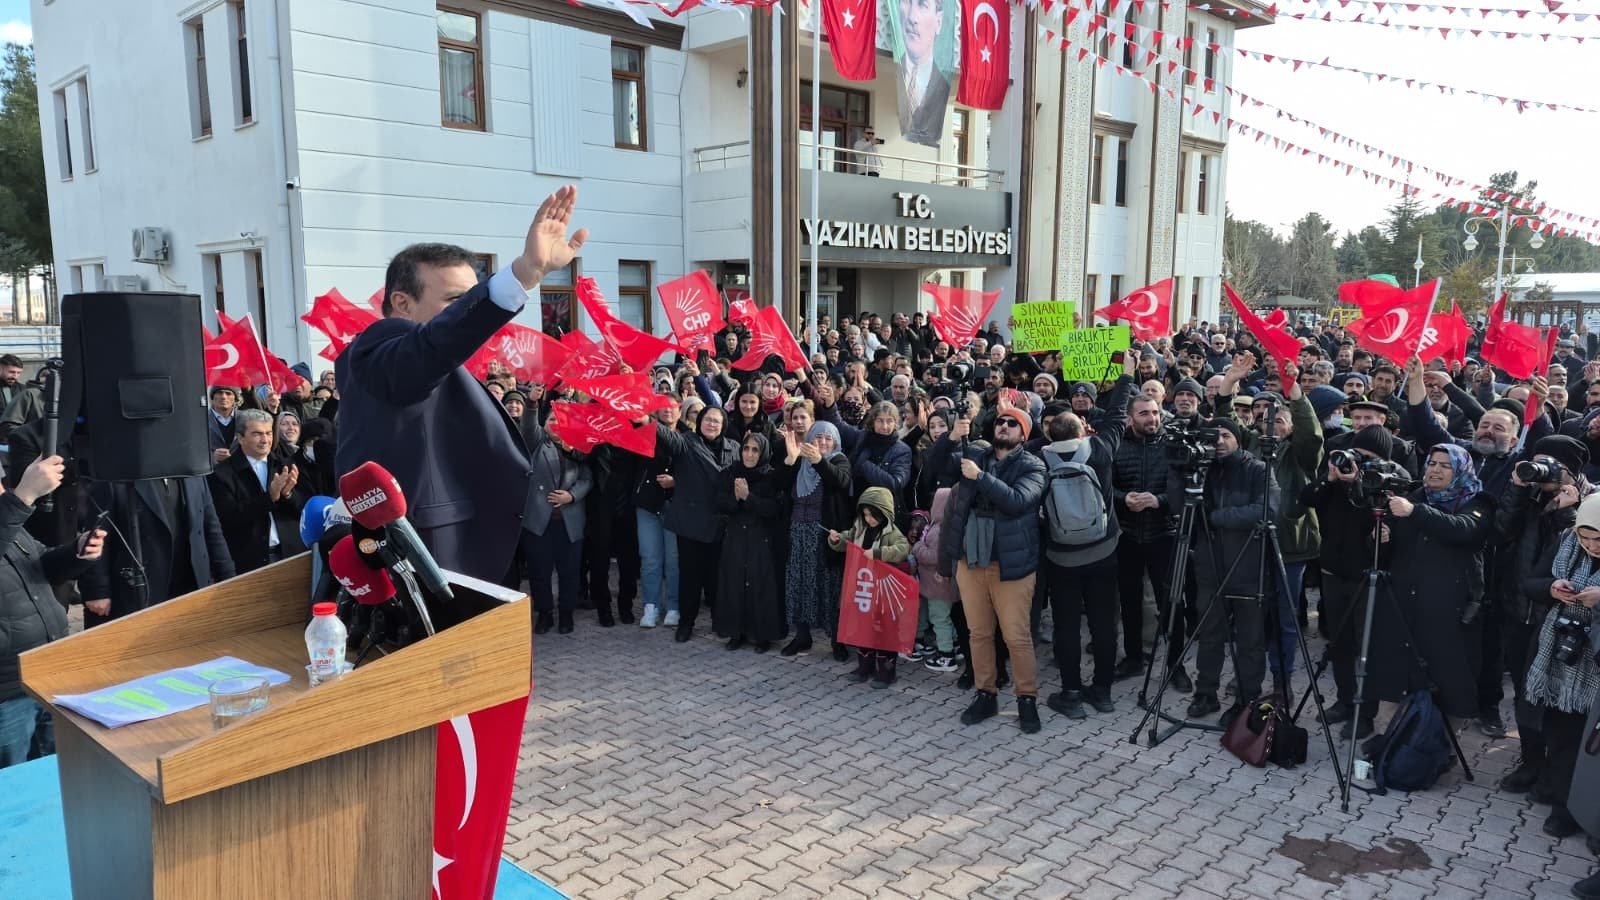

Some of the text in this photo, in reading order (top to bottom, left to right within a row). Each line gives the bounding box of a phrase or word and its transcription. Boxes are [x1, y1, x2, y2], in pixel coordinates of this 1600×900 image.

[898, 191, 935, 218] T.C.
[803, 218, 1012, 255] YAZIHAN BELEDİYESİ
[682, 311, 711, 331] CHP
[854, 567, 875, 613] CHP
